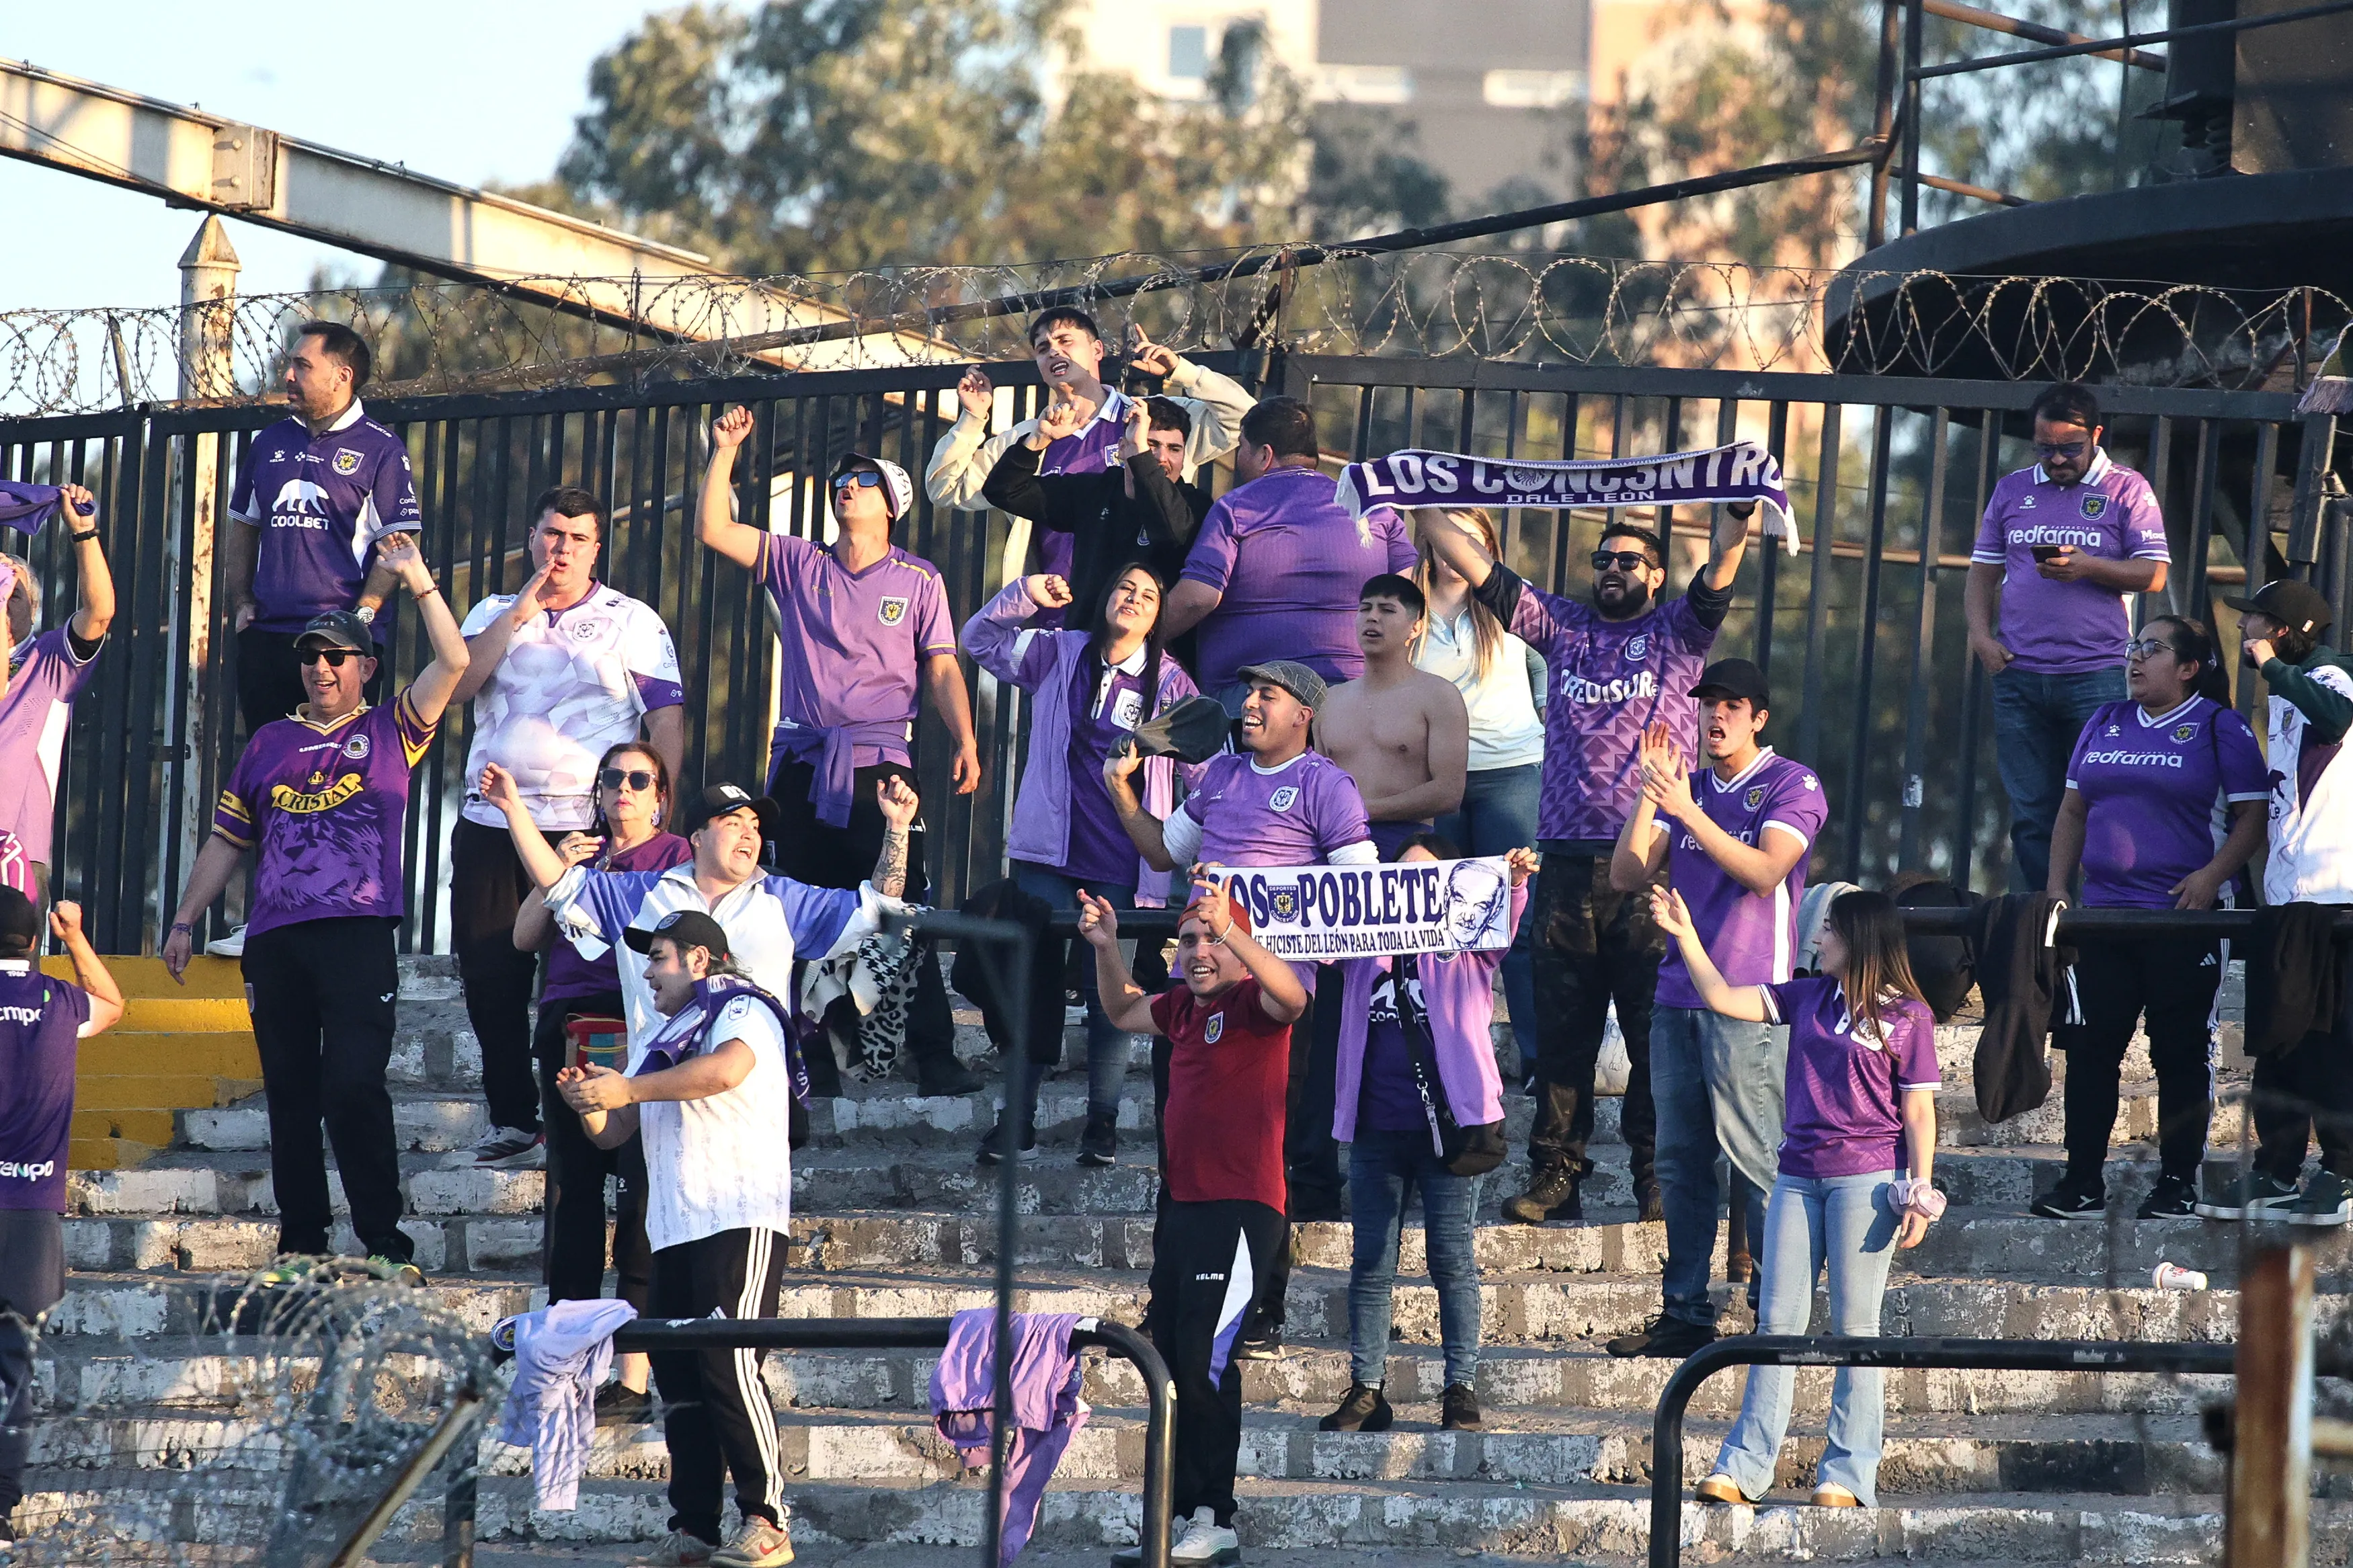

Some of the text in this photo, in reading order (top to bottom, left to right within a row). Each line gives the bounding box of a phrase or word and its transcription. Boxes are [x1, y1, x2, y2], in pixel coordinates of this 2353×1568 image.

[1360, 455, 1460, 496] LOS
[1506, 489, 1654, 503] DALE LEÓN
[270, 515, 329, 530] COOLBET
[2008, 524, 2101, 547] redfarma
[1560, 669, 1652, 704] CREDISUR
[2082, 750, 2182, 768] redfarma
[277, 782, 358, 811] CRISTAL
[1208, 867, 1443, 929] OS POBLETE
[1266, 934, 1304, 954] HICISTE
[1305, 934, 1323, 953] DEL
[1324, 928, 1349, 953] LEÓN
[1349, 932, 1376, 952] PARA
[1378, 931, 1404, 951] TODA
[1404, 930, 1419, 949] LA
